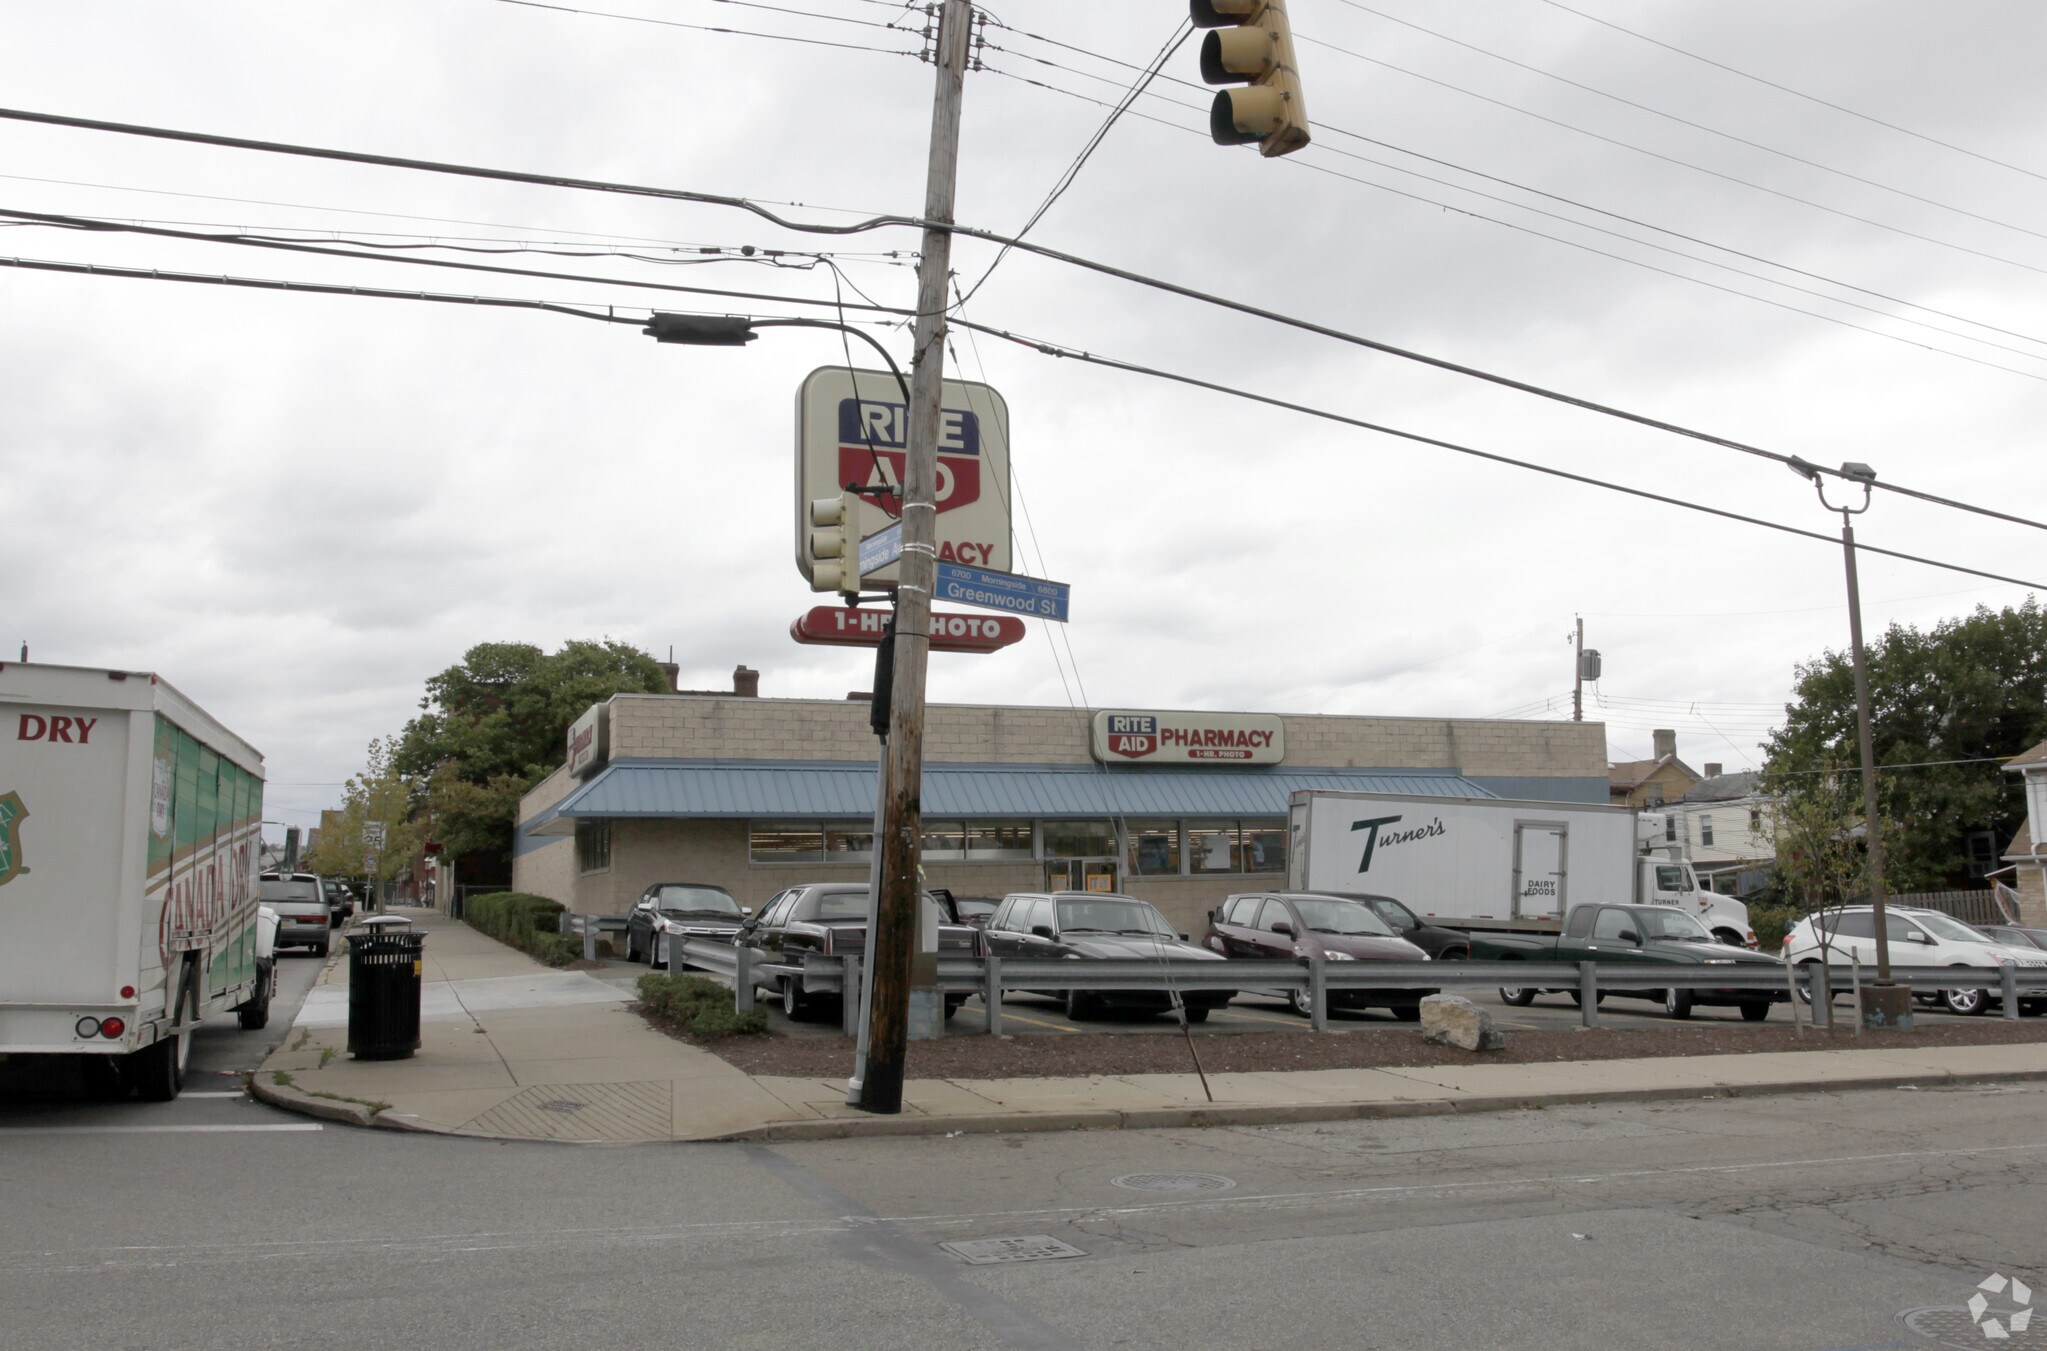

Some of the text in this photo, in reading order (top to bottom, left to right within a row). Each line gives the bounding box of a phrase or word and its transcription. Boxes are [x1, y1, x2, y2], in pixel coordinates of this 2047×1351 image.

[860, 403, 964, 449] RIE
[863, 456, 955, 501] AD
[952, 569, 1058, 596] 6700 Morningside 6800
[947, 582, 1057, 616] Greenwood St
[930, 617, 1001, 638] HOTO
[17, 714, 97, 744] DRY
[1113, 716, 1152, 733] RITE
[1118, 736, 1149, 752] AID
[1160, 728, 1274, 748] PHARMACY
[1195, 750, 1246, 758] 1-HR. PHOTO
[1350, 814, 1447, 874] Turner's
[1527, 888, 1556, 896] FOODS
[1528, 880, 1555, 888] DAIRY
[159, 840, 252, 971] CANADA DRY
[1654, 898, 1680, 906] TURNER
